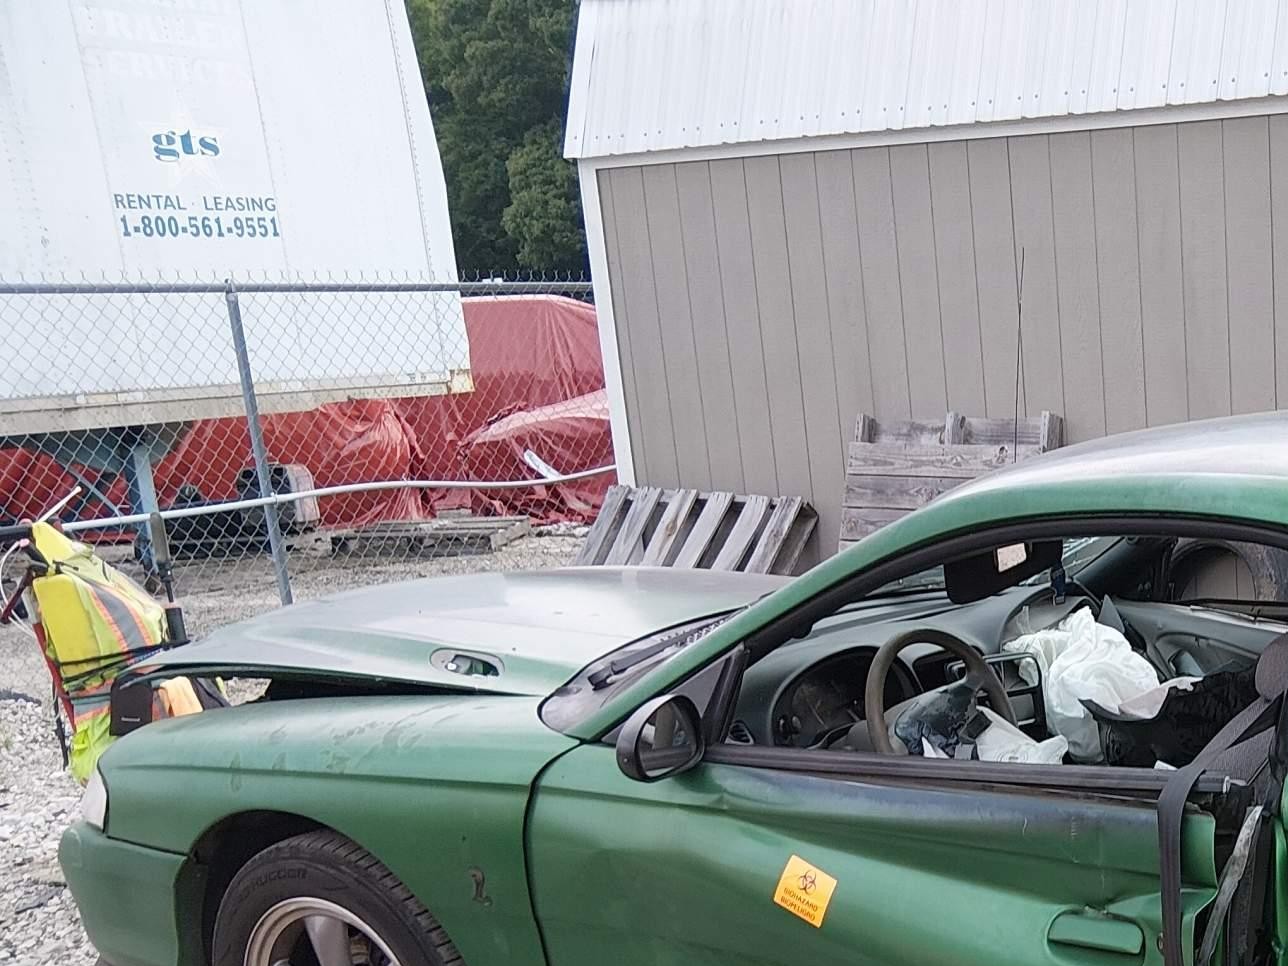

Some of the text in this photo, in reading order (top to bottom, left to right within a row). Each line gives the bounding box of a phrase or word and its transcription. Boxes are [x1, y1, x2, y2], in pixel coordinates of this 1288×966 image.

[152, 129, 220, 162] gts
[113, 193, 276, 212] RENTAL LEASING
[120, 214, 280, 238] 1-800-561-9551
[784, 887, 818, 912] BIOHAZARD
